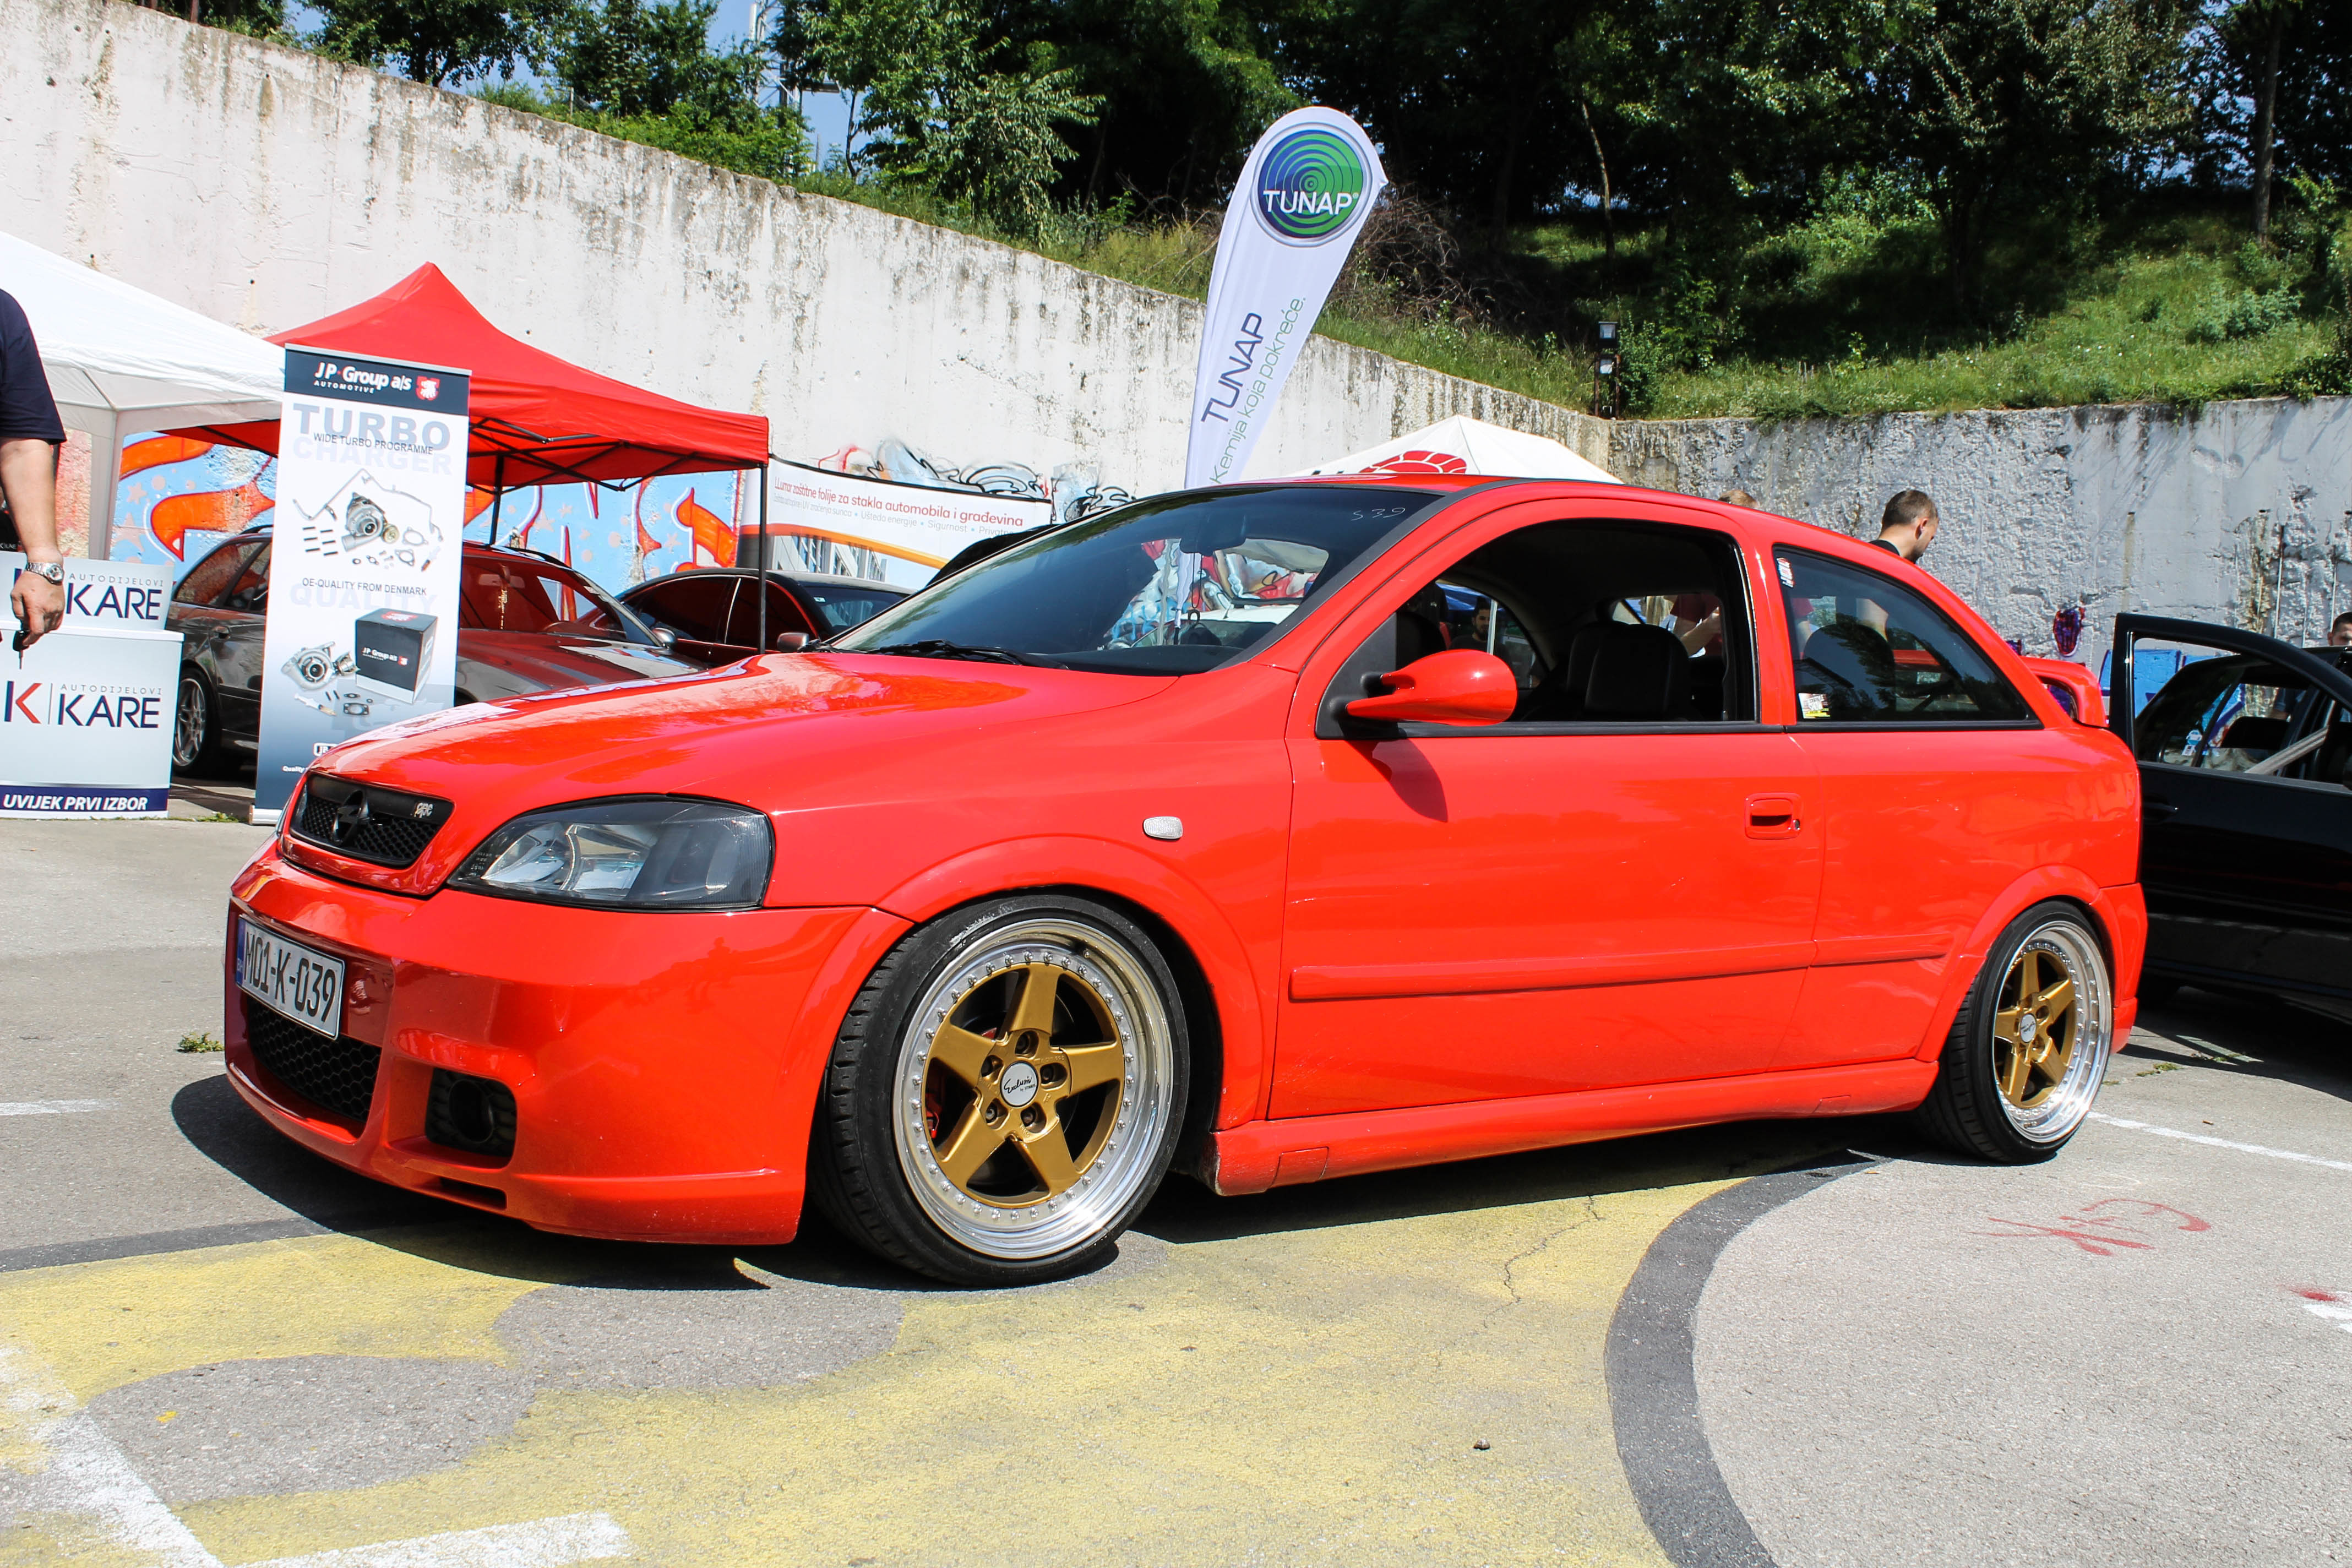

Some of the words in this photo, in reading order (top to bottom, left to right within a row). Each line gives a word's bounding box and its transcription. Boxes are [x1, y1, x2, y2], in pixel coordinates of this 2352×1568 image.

[1201, 313, 1264, 422] TUNAP
[313, 379, 375, 394] AUTOMOTIVE
[1209, 420, 1248, 484] Kemija
[1237, 379, 1267, 418] koja
[1259, 297, 1306, 380] pokreće.
[293, 402, 450, 451] TURBO
[293, 435, 452, 475] CHARGER
[314, 432, 337, 444] WIDE
[339, 435, 372, 448] TURBO
[374, 439, 434, 455] PROGRAMME
[818, 487, 836, 504] folije
[838, 494, 849, 504] za
[851, 496, 883, 509] stakla
[885, 501, 950, 519] automobila
[960, 511, 1023, 527] građevina
[888, 516, 918, 527] energije
[928, 519, 968, 532] Sigurnost
[69, 573, 164, 587] AUTODIJELOVI
[302, 578, 355, 590] OE-QUALITY
[358, 582, 382, 592] FROM
[385, 584, 427, 596] DENMARK
[66, 582, 162, 620] KARE
[290, 582, 438, 613] QUALITY
[59, 683, 162, 695] AUTODIJELOVI
[58, 694, 161, 728] KARE
[3, 794, 64, 810] UVIJEK
[64, 796, 102, 810] PRVI
[102, 797, 148, 811] IZBOR
